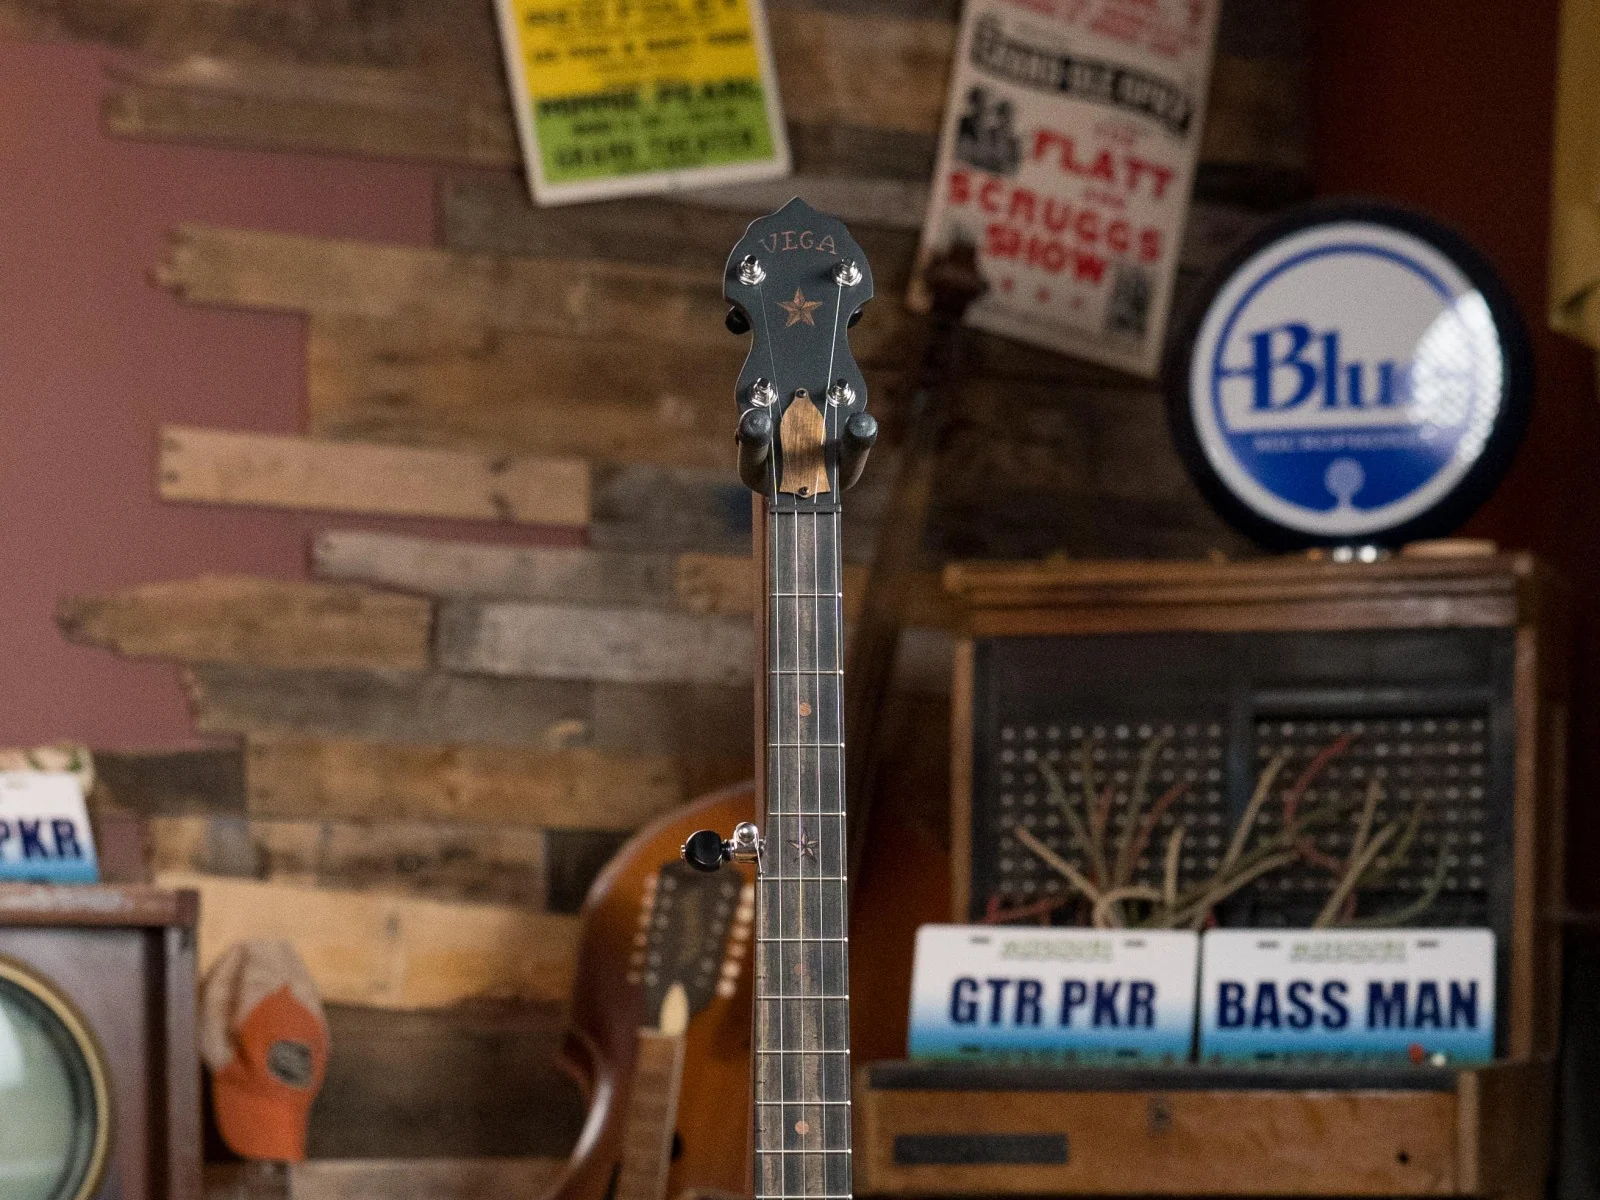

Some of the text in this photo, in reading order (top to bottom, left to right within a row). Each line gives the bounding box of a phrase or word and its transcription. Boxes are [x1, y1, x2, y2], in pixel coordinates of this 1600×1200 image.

[1033, 129, 1176, 199] FLATT
[758, 230, 837, 255] VEGA
[949, 169, 1162, 264] SCRUGGS
[985, 222, 1109, 286] SHOW
[1247, 321, 1432, 414] Blu
[949, 976, 1157, 1028] GTR PKR
[1216, 980, 1480, 1030] BASS MAN
